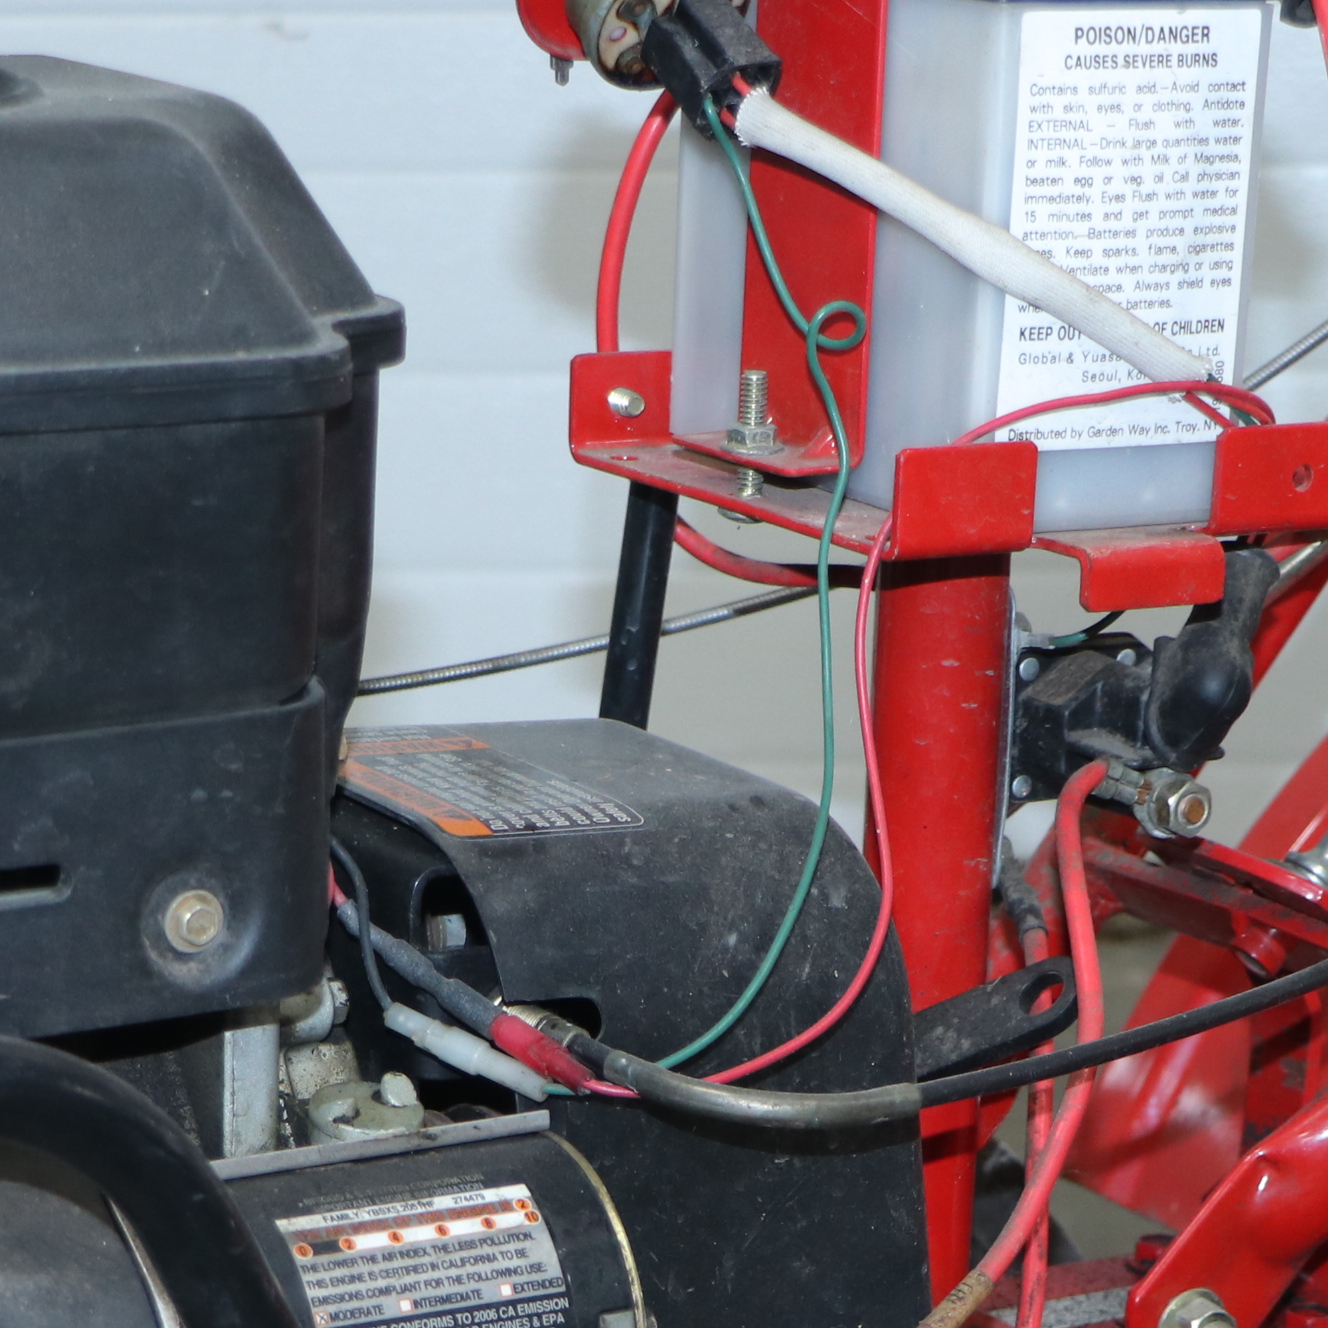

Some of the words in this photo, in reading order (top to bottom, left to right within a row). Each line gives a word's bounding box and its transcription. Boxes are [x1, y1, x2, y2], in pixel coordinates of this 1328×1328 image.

[1074, 25, 1210, 45] POISON/DANGER
[1063, 53, 1118, 70] CAUSES
[1122, 53, 1172, 69] SEVERE
[1176, 52, 1218, 68] BURNS
[1029, 82, 1078, 97] Contains
[1087, 81, 1126, 95] sulfuric
[1207, 80, 1246, 93] contact
[1028, 101, 1054, 114] with
[1062, 101, 1088, 115] skin,
[1096, 102, 1124, 115] eyes,
[1132, 102, 1144, 113] or
[1151, 99, 1194, 113] clothing.
[1201, 97, 1245, 111] Antidote
[1027, 118, 1093, 133] EXTERNAL
[1127, 117, 1156, 131] Flush
[1173, 116, 1195, 129] with
[1211, 116, 1244, 128] water.
[1130, 137, 1157, 151] large
[1161, 134, 1209, 149] quantities
[1213, 134, 1243, 146] water
[1025, 158, 1038, 169] or
[1044, 155, 1071, 168] milk.
[1078, 154, 1113, 168] Follow
[1120, 153, 1144, 167] with
[1150, 152, 1170, 165] Milk
[1176, 152, 1188, 165] of
[1193, 151, 1241, 166] Magnesia,
[1024, 174, 1064, 187] beaten
[1072, 175, 1094, 189] egg
[1102, 175, 1114, 186] or
[1122, 174, 1145, 187] veg.
[1171, 170, 1190, 183] Call
[1196, 168, 1240, 184] physician
[1023, 191, 1094, 205] immediately.
[1100, 190, 1126, 205] Eyes
[1131, 189, 1159, 202] Flush
[1163, 188, 1186, 201] with
[1191, 188, 1219, 200] water
[1224, 185, 1239, 198] for
[1024, 209, 1036, 223] 15
[1047, 210, 1092, 222] minutes
[1102, 208, 1123, 222] and
[1131, 208, 1150, 223] get
[1157, 207, 1194, 221] prompt
[1202, 203, 1238, 217] medical
[1146, 227, 1185, 241] produce
[1193, 223, 1237, 237] explosive
[1065, 245, 1093, 260] Keep
[1186, 241, 1234, 256] cigarettes
[1115, 262, 1143, 275] when
[1147, 259, 1189, 275] charging
[1193, 261, 1204, 271] or
[1208, 258, 1233, 272] using
[1132, 279, 1170, 292] Always
[1176, 276, 1204, 290] shield
[1209, 276, 1232, 289] eyes
[1123, 298, 1172, 312] batteries.
[1018, 325, 1053, 341] KEEP
[1170, 318, 1225, 336] CHILDREN
[1017, 351, 1061, 365] Global
[1065, 351, 1074, 365] &
[1081, 369, 1121, 383] Seoul,
[1007, 427, 1067, 442] Distributed
[1069, 426, 1083, 440] by
[1086, 424, 1124, 438] Garden
[1127, 423, 1151, 436] Way
[1153, 422, 1170, 434] Inc.
[299, 1261, 320, 1274] THE
[320, 1255, 359, 1271] LOWER
[359, 1252, 380, 1265] THE
[380, 1249, 398, 1262] AIR
[430, 1242, 451, 1255] THE
[451, 1238, 478, 1252] LESS
[477, 1230, 534, 1248] POLLUTION.
[304, 1276, 328, 1290] THIS
[328, 1271, 366, 1286] ENGINE
[367, 1269, 378, 1281] IS
[378, 1262, 429, 1279] CERTIFIED
[429, 1260, 440, 1272] IN
[440, 1251, 499, 1270] CALIFORNIA
[498, 1249, 514, 1262] TO
[513, 1247, 529, 1259] BE
[310, 1289, 364, 1307] EMISSIONS
[365, 1280, 422, 1299] COMPLIANT
[423, 1277, 445, 1290] FOR
[445, 1274, 466, 1287] THE
[466, 1265, 524, 1284] FOLLOWING
[328, 1304, 384, 1322] MODERATE
[412, 1289, 483, 1310] INTERMEDIATE
[512, 1276, 565, 1294] EXTENDED
[455, 1311, 472, 1325] TO
[472, 1307, 497, 1323] 2006
[498, 1305, 515, 1319] CA
[517, 1297, 569, 1316] EMISSION
[531, 1316, 540, 1328] &
[542, 1312, 564, 1327] EPA
